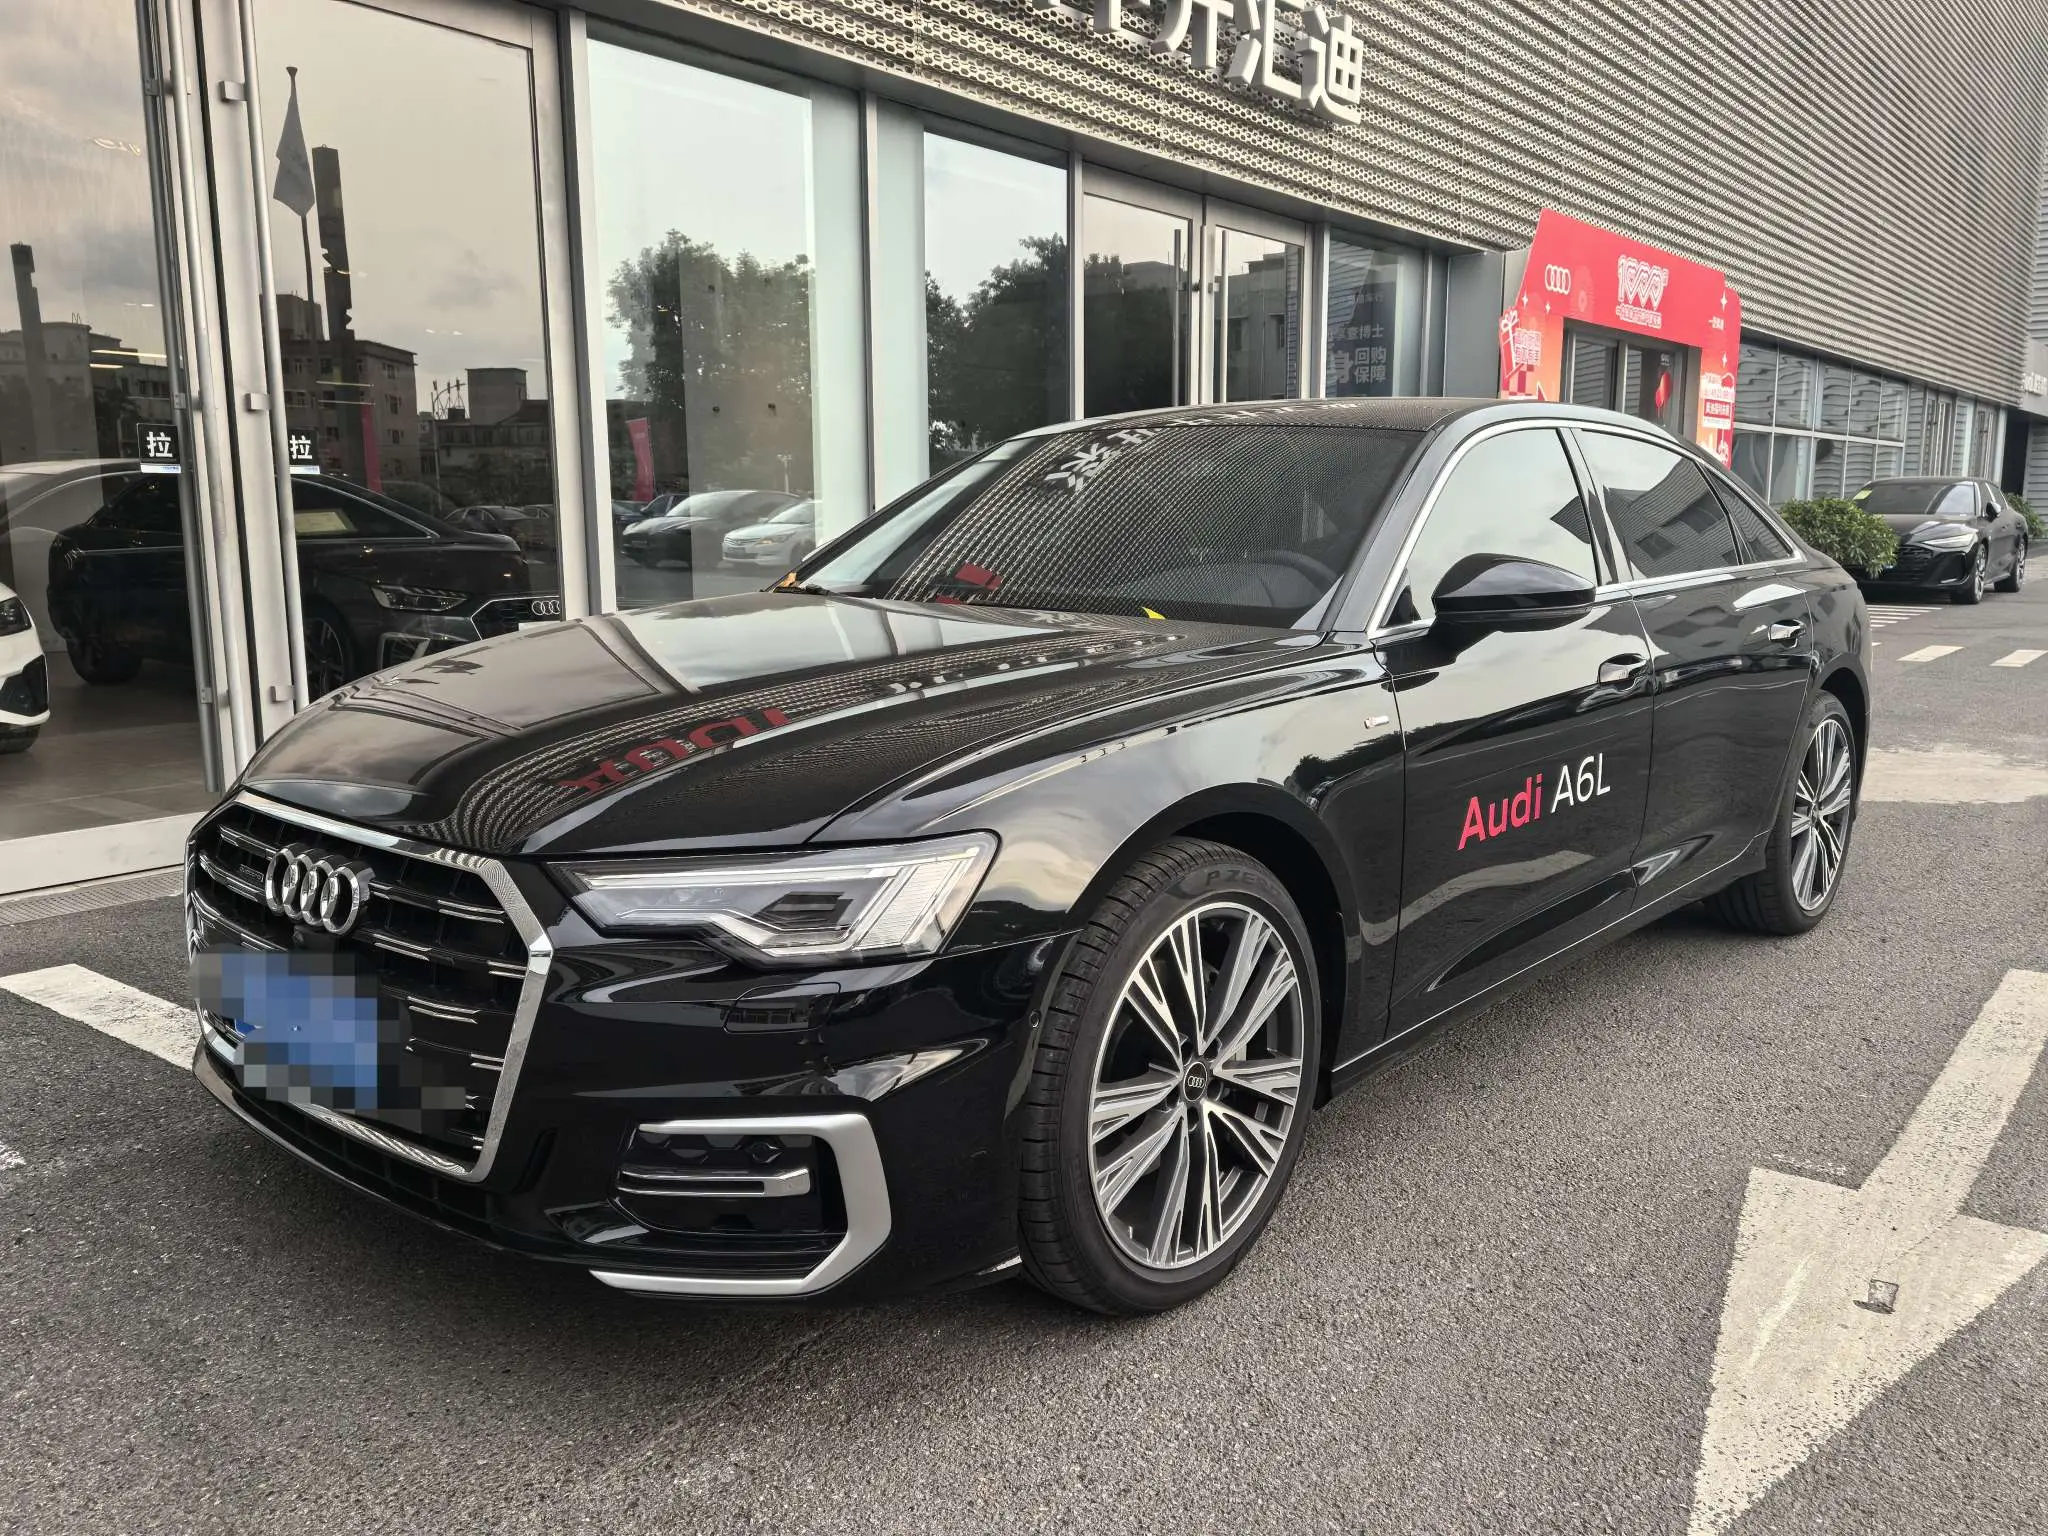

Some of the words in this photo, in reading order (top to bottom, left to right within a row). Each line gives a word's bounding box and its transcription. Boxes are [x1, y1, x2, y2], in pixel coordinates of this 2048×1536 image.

[1355, 346, 1387, 365] 回购
[1355, 365, 1387, 384] 保障
[146, 431, 173, 458] 拉
[289, 434, 313, 460] 拉
[1456, 772, 1544, 851] Audi
[1550, 752, 1611, 814] A6L
